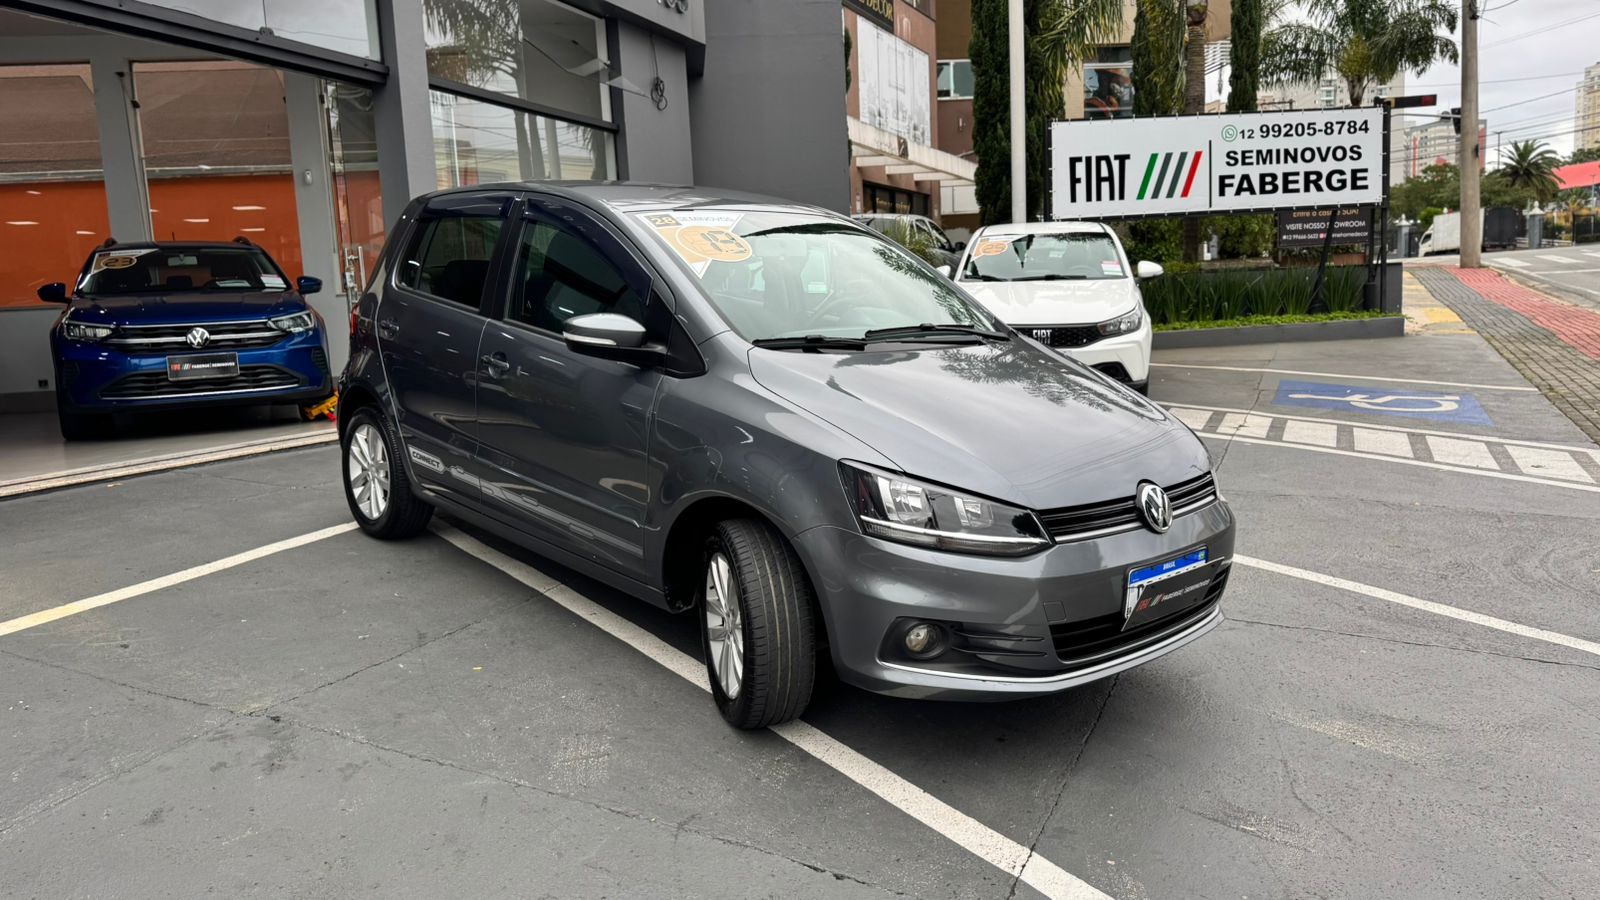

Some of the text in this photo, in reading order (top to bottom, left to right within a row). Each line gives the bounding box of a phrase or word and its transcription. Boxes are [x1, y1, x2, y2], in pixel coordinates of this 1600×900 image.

[1239, 120, 1370, 139] 12 99205-8784
[1225, 145, 1363, 167] SEMINOVOS
[1069, 154, 1131, 203] FIAT
[1218, 168, 1369, 197] FABERGE
[1032, 329, 1053, 338] FIAT
